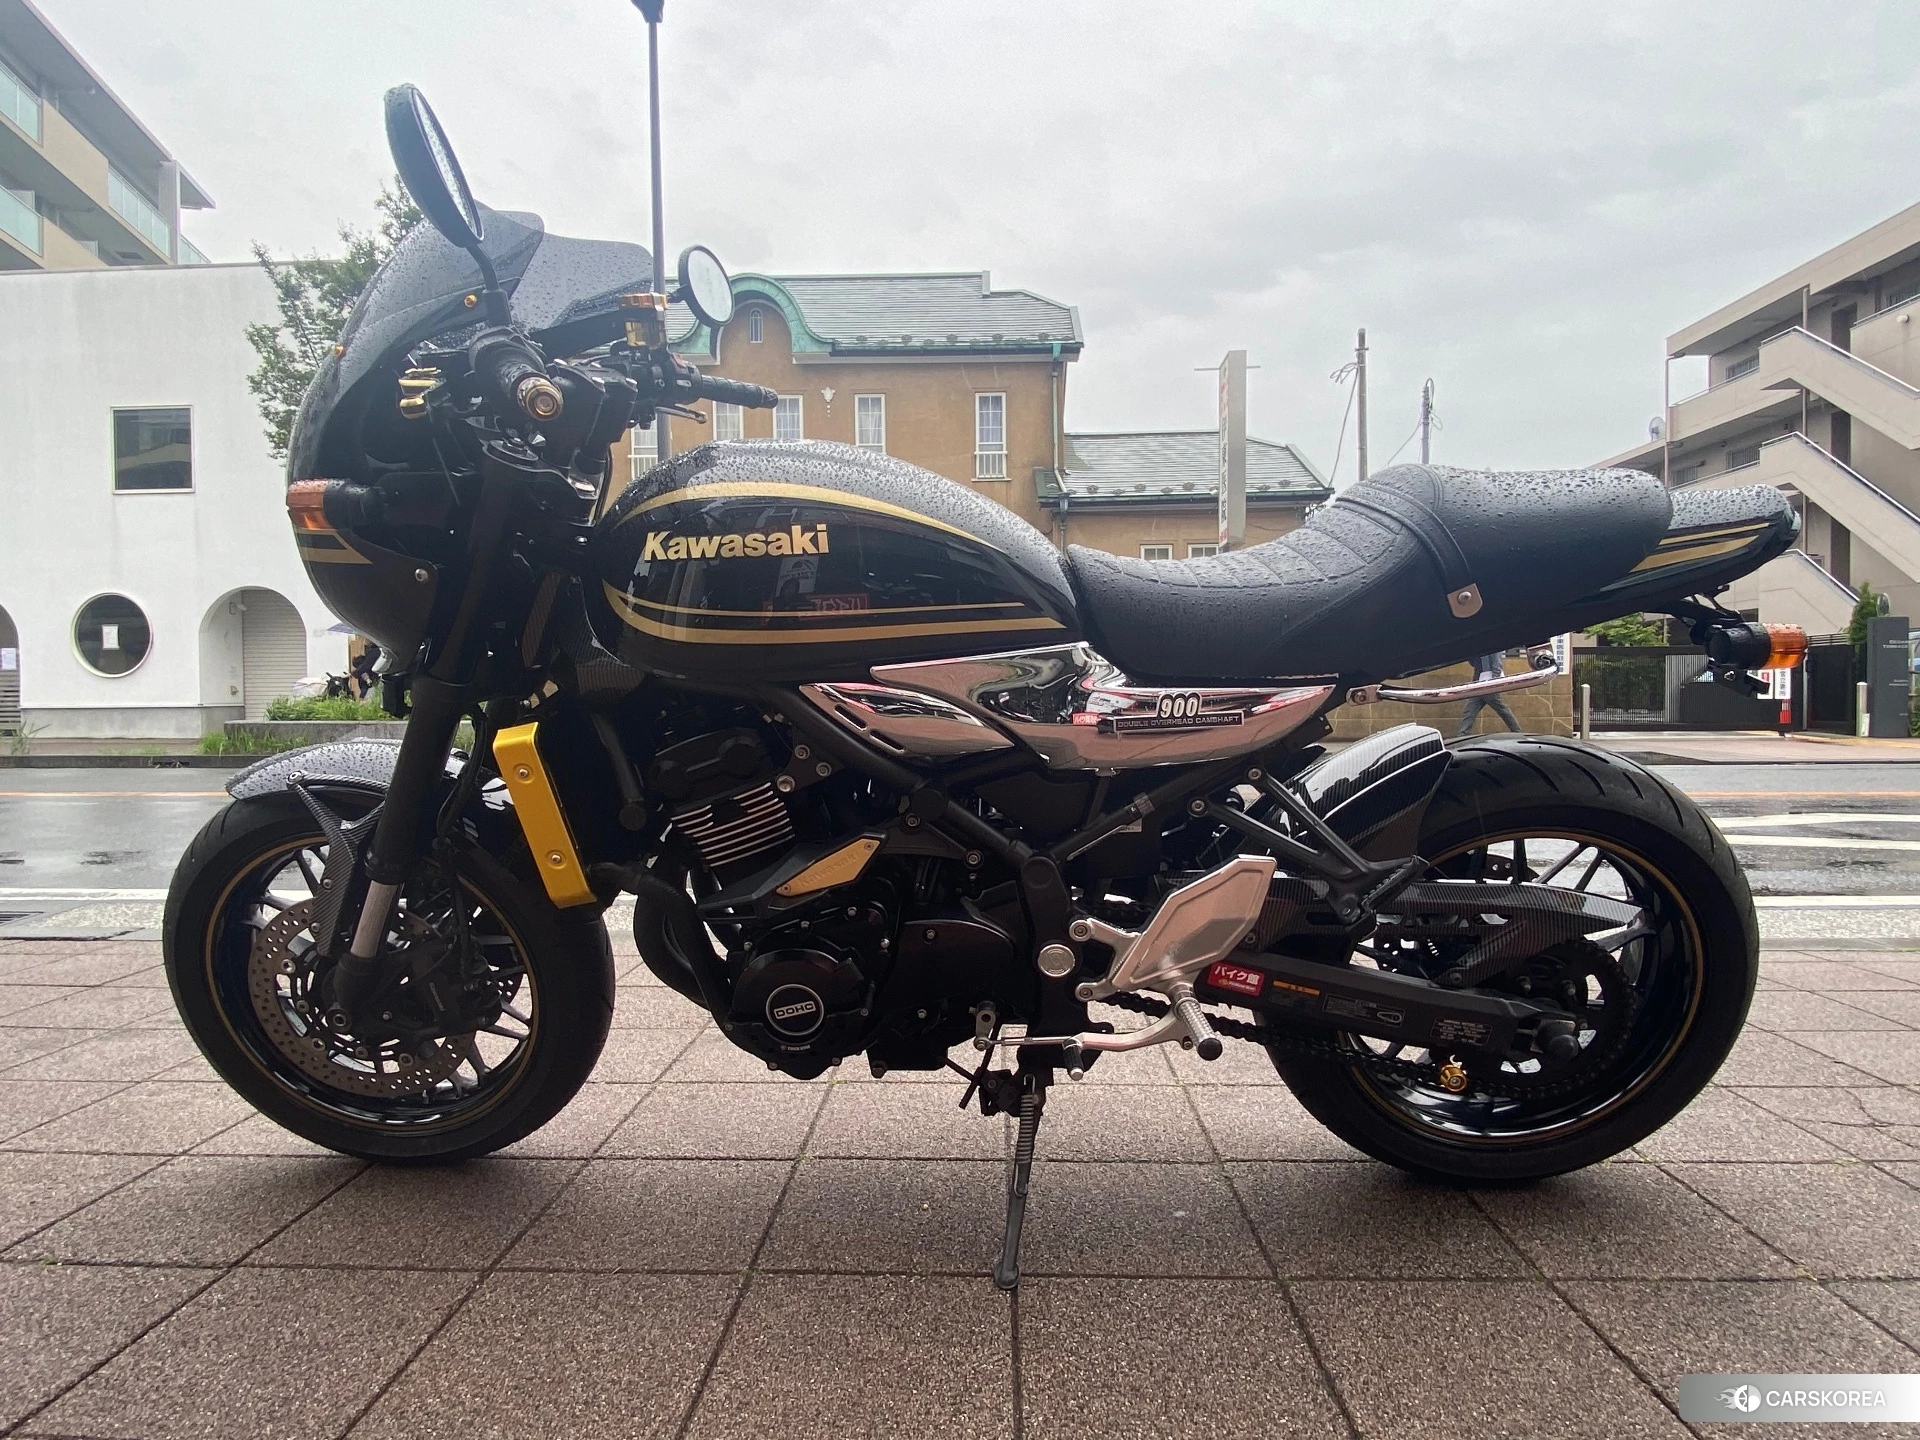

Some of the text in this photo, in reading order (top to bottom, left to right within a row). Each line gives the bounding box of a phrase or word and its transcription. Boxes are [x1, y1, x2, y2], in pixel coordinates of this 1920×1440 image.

[644, 523, 829, 561] Kawasaki
[1160, 698, 1199, 718] 900
[1117, 715, 1240, 728] DOUBLE OVERHEAD CAMSHAFT
[1214, 965, 1260, 985] バイク館
[775, 1003, 814, 1018] DOHC
